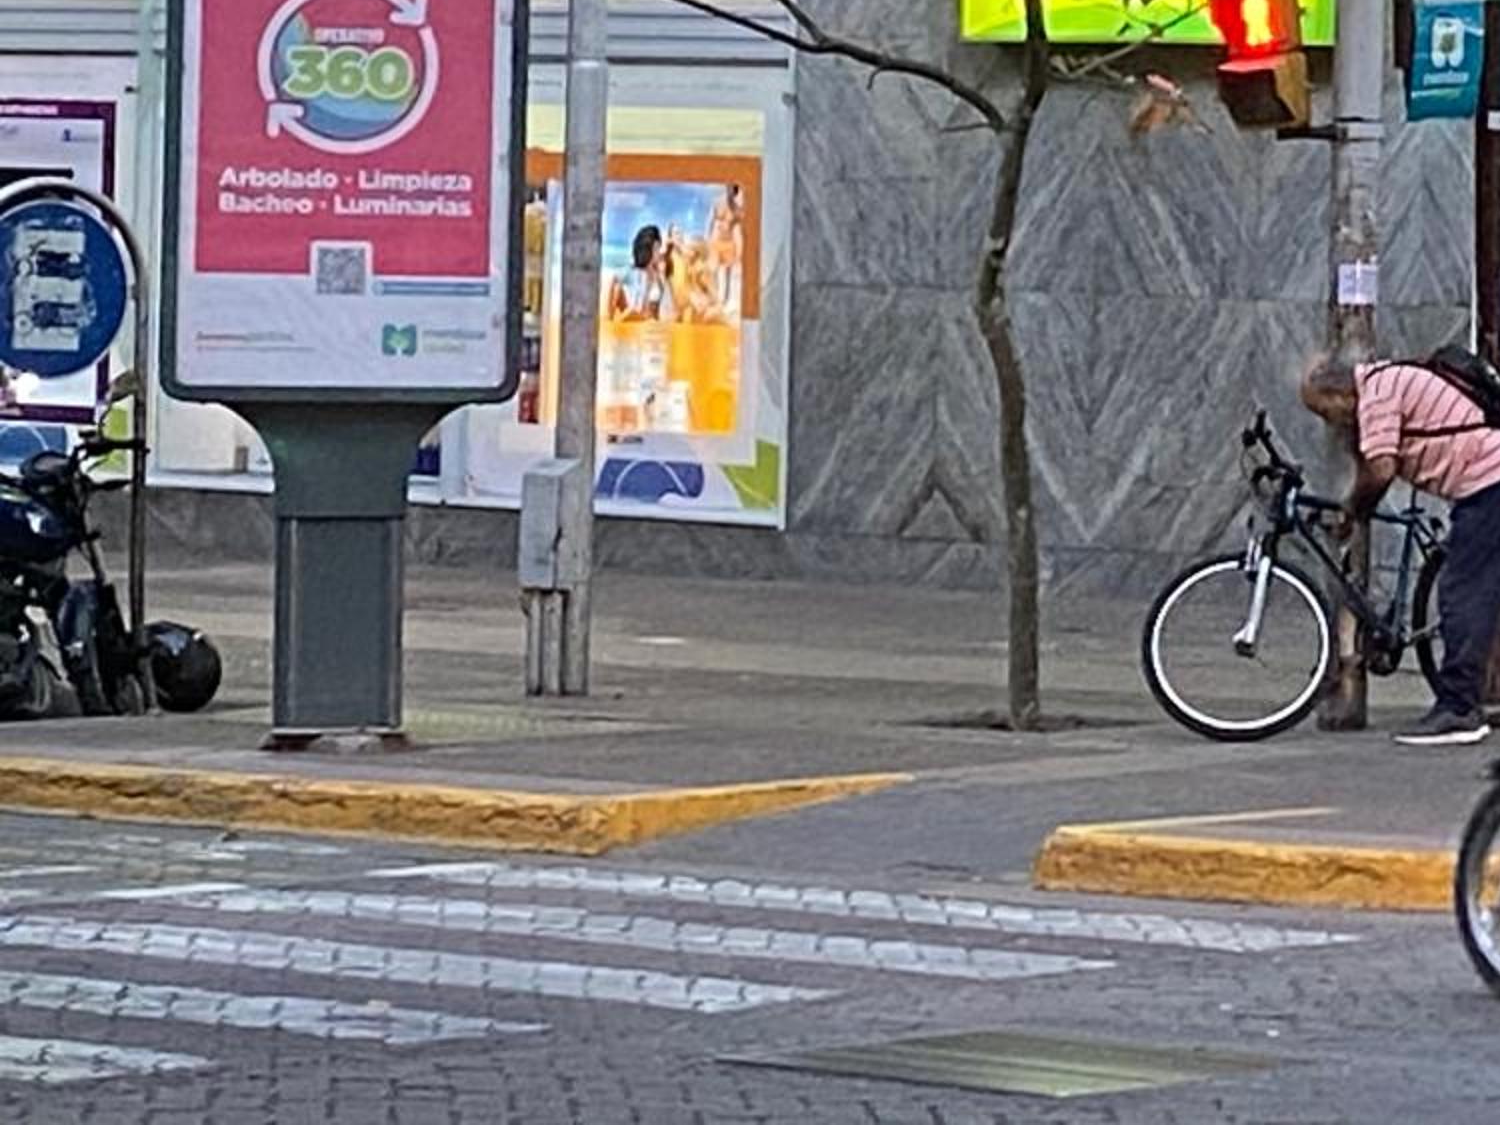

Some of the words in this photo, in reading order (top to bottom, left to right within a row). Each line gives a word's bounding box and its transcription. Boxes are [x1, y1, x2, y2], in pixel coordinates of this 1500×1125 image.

[284, 45, 415, 100] 360
[218, 166, 338, 189] Arbolado
[358, 169, 473, 192] Limpieza
[218, 192, 313, 214] Bacheo
[333, 194, 473, 217] Luminarias
